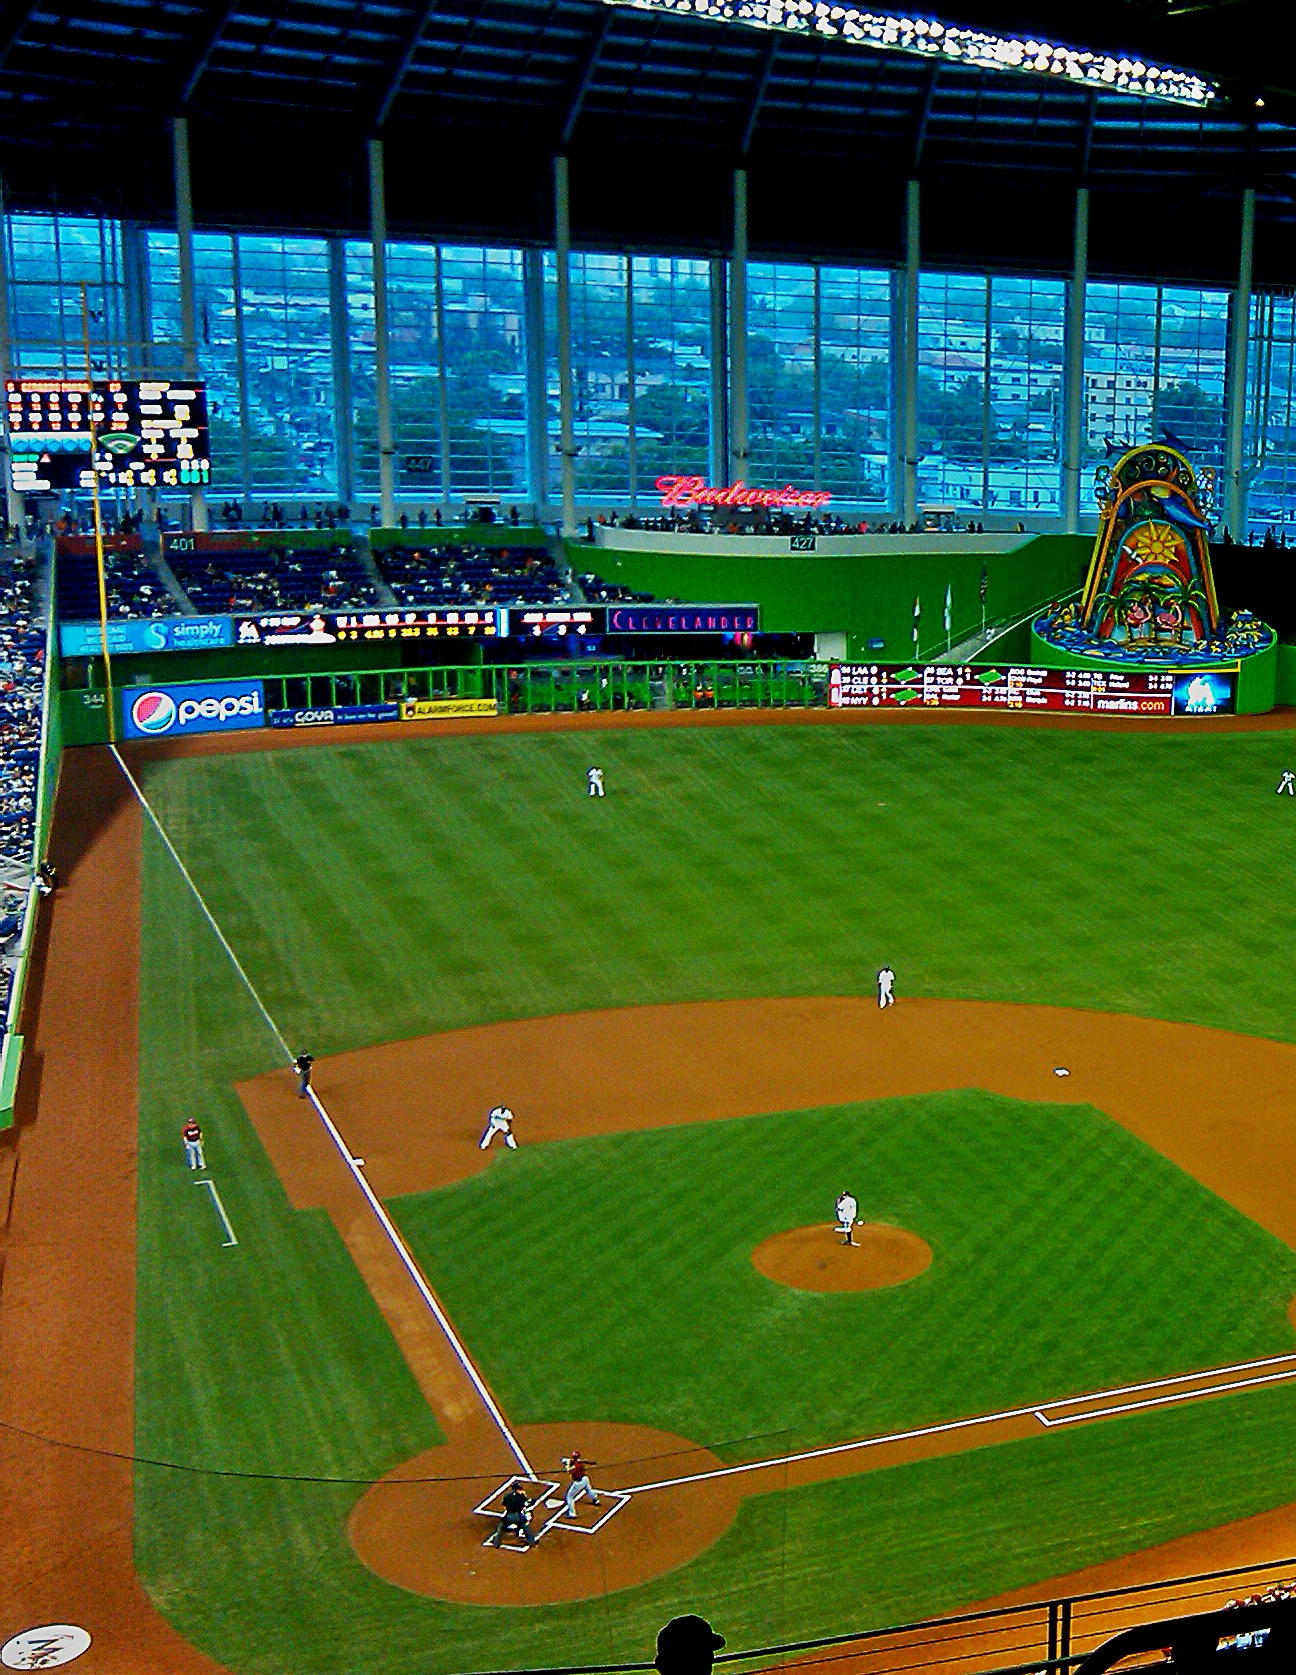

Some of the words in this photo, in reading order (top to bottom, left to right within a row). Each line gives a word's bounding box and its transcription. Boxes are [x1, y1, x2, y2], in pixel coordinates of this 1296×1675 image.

[655, 475, 832, 507] Budweiser
[169, 538, 195, 550] 401
[791, 538, 813, 549] 427
[613, 610, 753, 629] CLEVELANDER
[173, 621, 223, 638] simply
[180, 691, 262, 725] pepsi
[1097, 699, 1164, 711] marlins.com
[295, 709, 333, 723] GOYA
